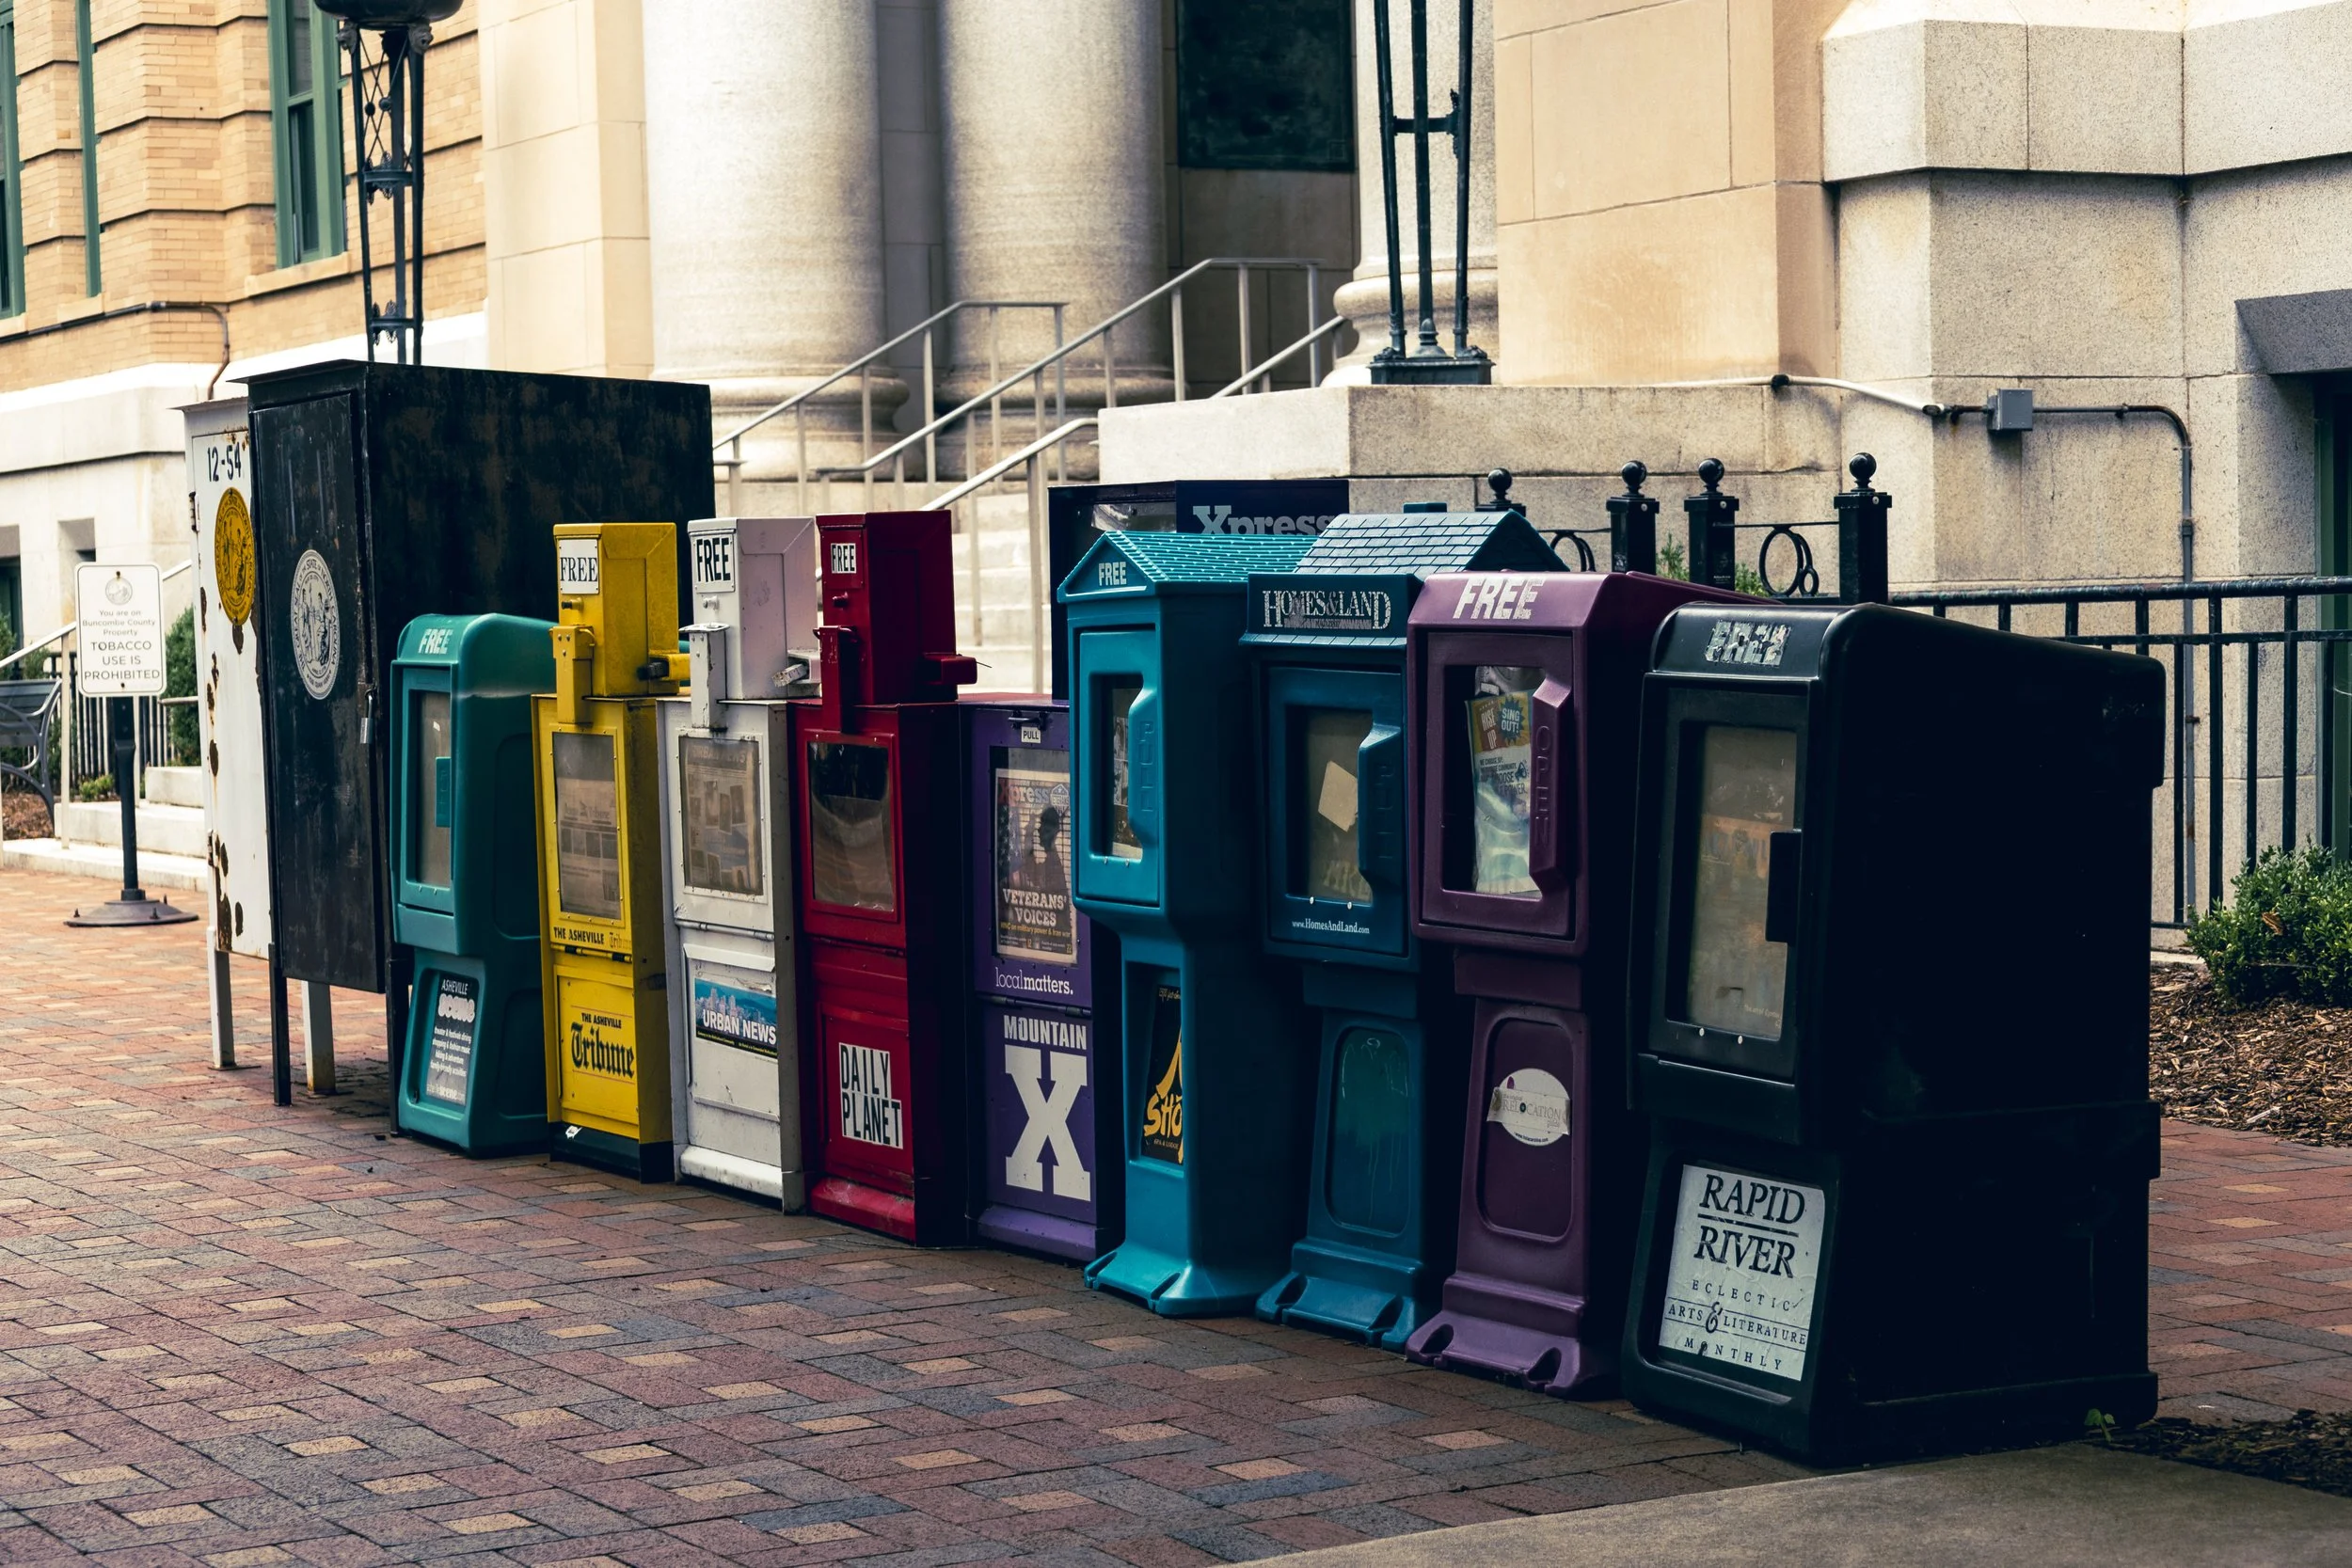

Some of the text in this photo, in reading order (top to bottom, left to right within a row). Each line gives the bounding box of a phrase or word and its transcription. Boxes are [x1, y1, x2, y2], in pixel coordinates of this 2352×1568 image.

[207, 441, 242, 483] 12-54
[560, 557, 598, 582] FREE
[696, 537, 731, 582] FREE
[831, 545, 855, 574] FREE
[1099, 561, 1127, 587] FREE
[1452, 577, 1546, 620] FREE
[103, 628, 138, 637] Property
[127, 618, 156, 626] County
[90, 641, 152, 652] TOBACCO
[418, 627, 453, 655] FREE
[102, 655, 141, 666] USE IS
[84, 669, 160, 680] PROHIBITED
[1480, 707, 1496, 733] RISE
[1501, 720, 1519, 734] OUT!
[1502, 707, 1520, 722] SING
[1023, 730, 1040, 740] PULL
[1486, 730, 1498, 750] UP
[1002, 888, 1067, 911] VETERANS'
[1014, 907, 1057, 927] VOICES
[1292, 918, 1370, 934] www.HomesAndLand.com
[553, 927, 566, 940] THE
[568, 928, 605, 944] ASHEVILLE
[441, 978, 469, 995] ASHEVILLE
[995, 967, 1074, 995] localmatters.
[437, 992, 475, 1023] scene
[581, 1012, 622, 1030] THE ASHEVILLE
[703, 1008, 740, 1036] URBAN
[742, 1019, 777, 1045] NEWS
[1003, 1014, 1087, 1051] MOUNTAIN
[571, 1021, 635, 1079] Tribune
[840, 1044, 889, 1099] DAILY
[842, 1091, 900, 1147] PLANET
[1005, 1044, 1091, 1202] X
[1502, 1099, 1561, 1121] RELOCATION
[1699, 1174, 1805, 1225] RAPID
[1693, 1225, 1796, 1279] RIVER
[1692, 1279, 1790, 1312] ECLECTIC
[1668, 1304, 1703, 1322] ARTS
[1724, 1315, 1807, 1345] LITERATURE
[1684, 1337, 1782, 1370] MONTHLY
